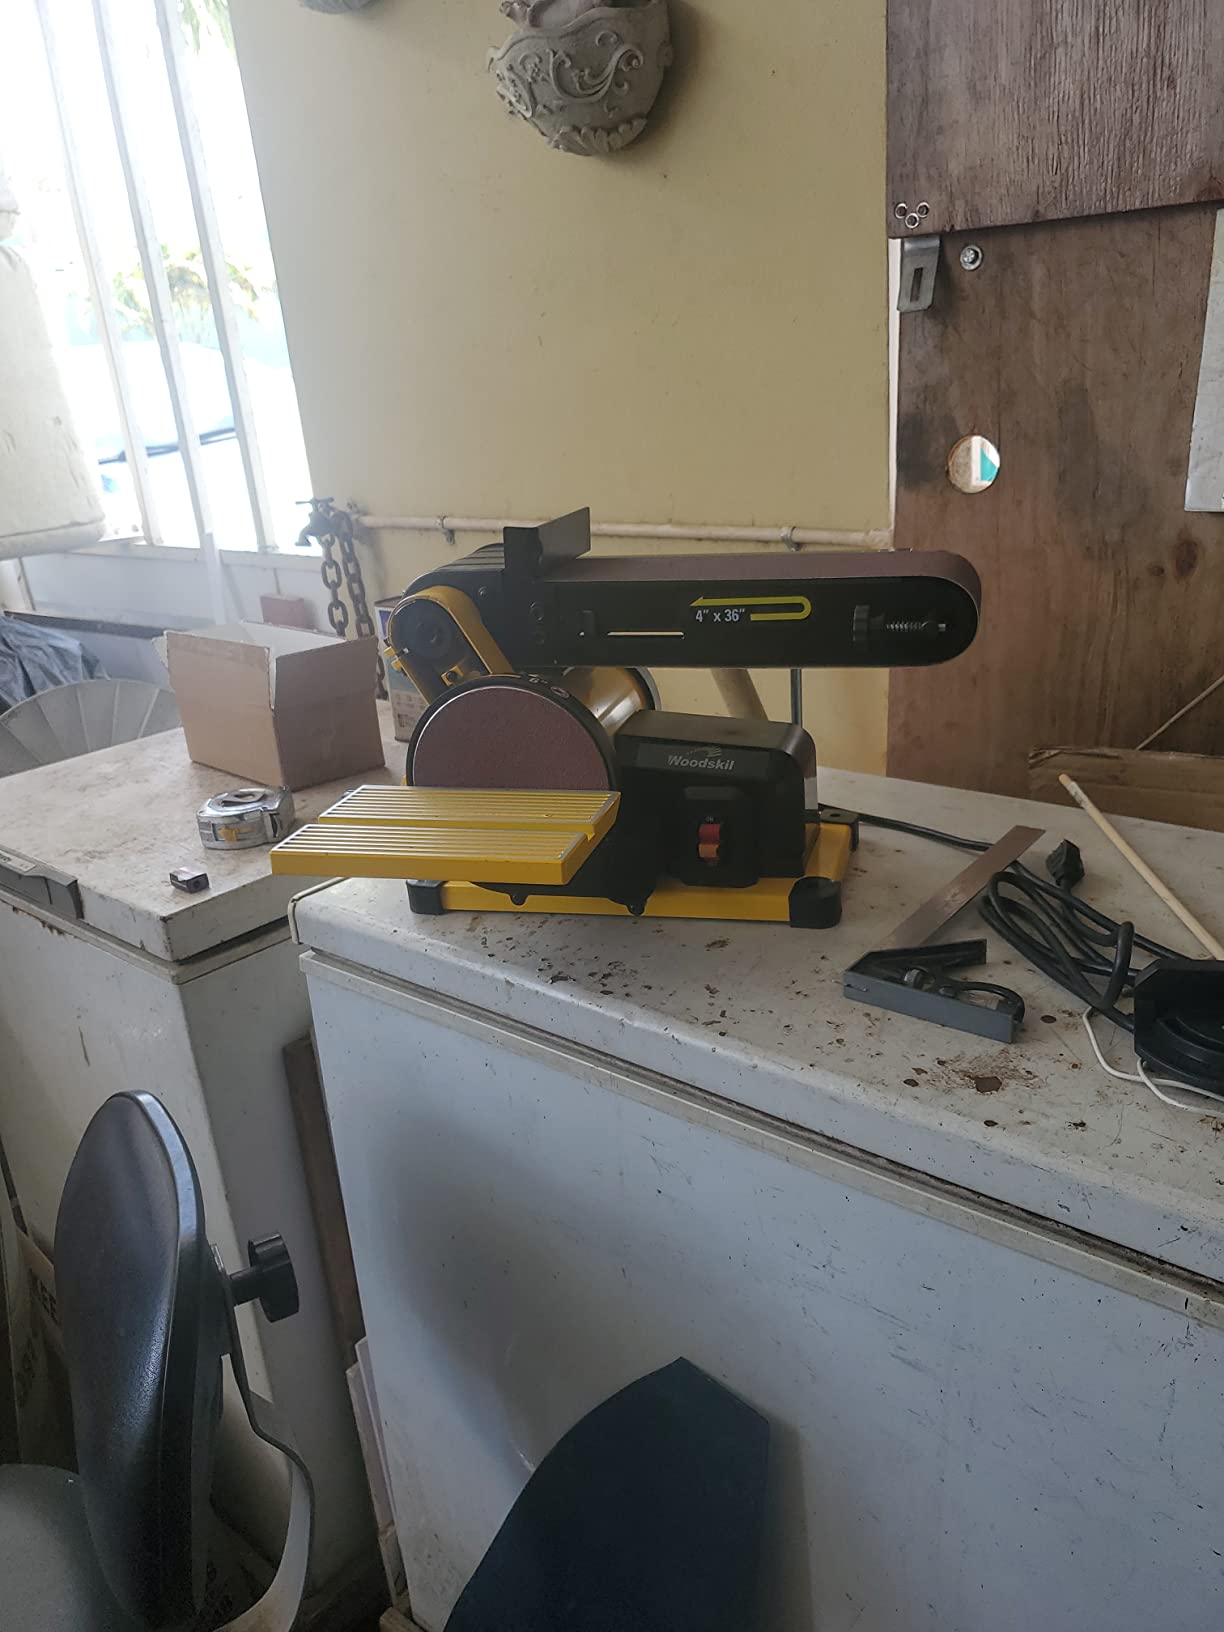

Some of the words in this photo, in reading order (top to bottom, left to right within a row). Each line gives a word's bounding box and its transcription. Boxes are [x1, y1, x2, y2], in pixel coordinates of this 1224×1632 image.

[695, 609, 709, 623] 4"
[713, 614, 721, 622] x
[724, 608, 746, 622] 36"
[668, 755, 735, 770] Woodskil
